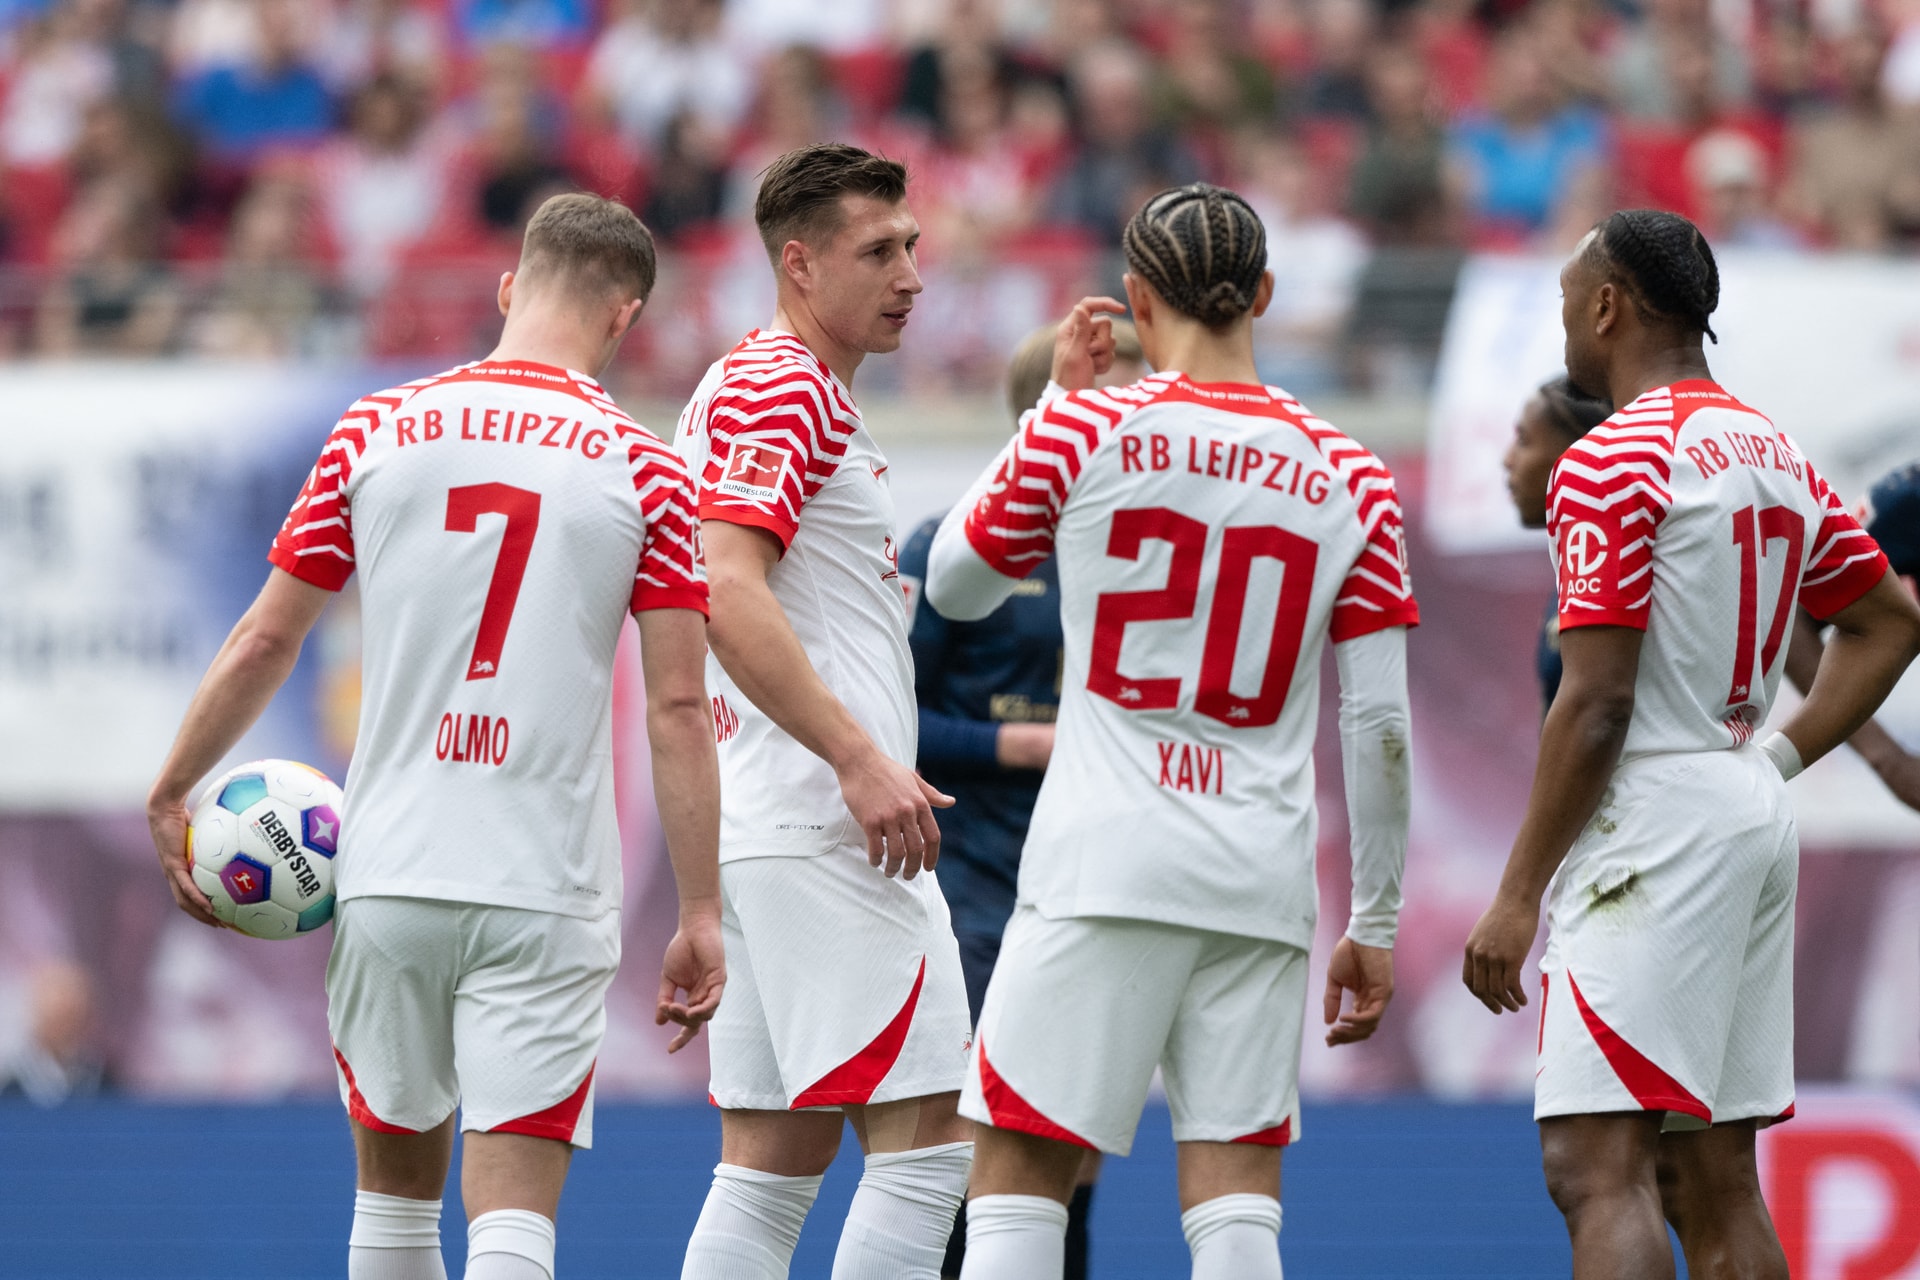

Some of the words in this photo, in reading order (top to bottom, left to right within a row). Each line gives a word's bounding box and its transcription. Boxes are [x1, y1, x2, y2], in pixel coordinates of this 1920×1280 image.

[523, 370, 568, 384] ANYTHING
[396, 409, 444, 447] RB
[460, 407, 610, 460] LEIPZIG
[1684, 437, 1730, 480] RB
[1723, 431, 1802, 482] LEIPZIG
[723, 483, 773, 498] BUNDESLIGA
[1121, 434, 1171, 473] RB
[1187, 436, 1331, 506] LEIPZIG
[444, 481, 542, 682] 7
[1567, 577, 1601, 596] AOC
[1726, 504, 1805, 706] 17
[1085, 506, 1320, 729] 20
[436, 712, 509, 767] OLMO
[1158, 741, 1223, 796] XAVI
[258, 810, 321, 898] DERBYSTAR
